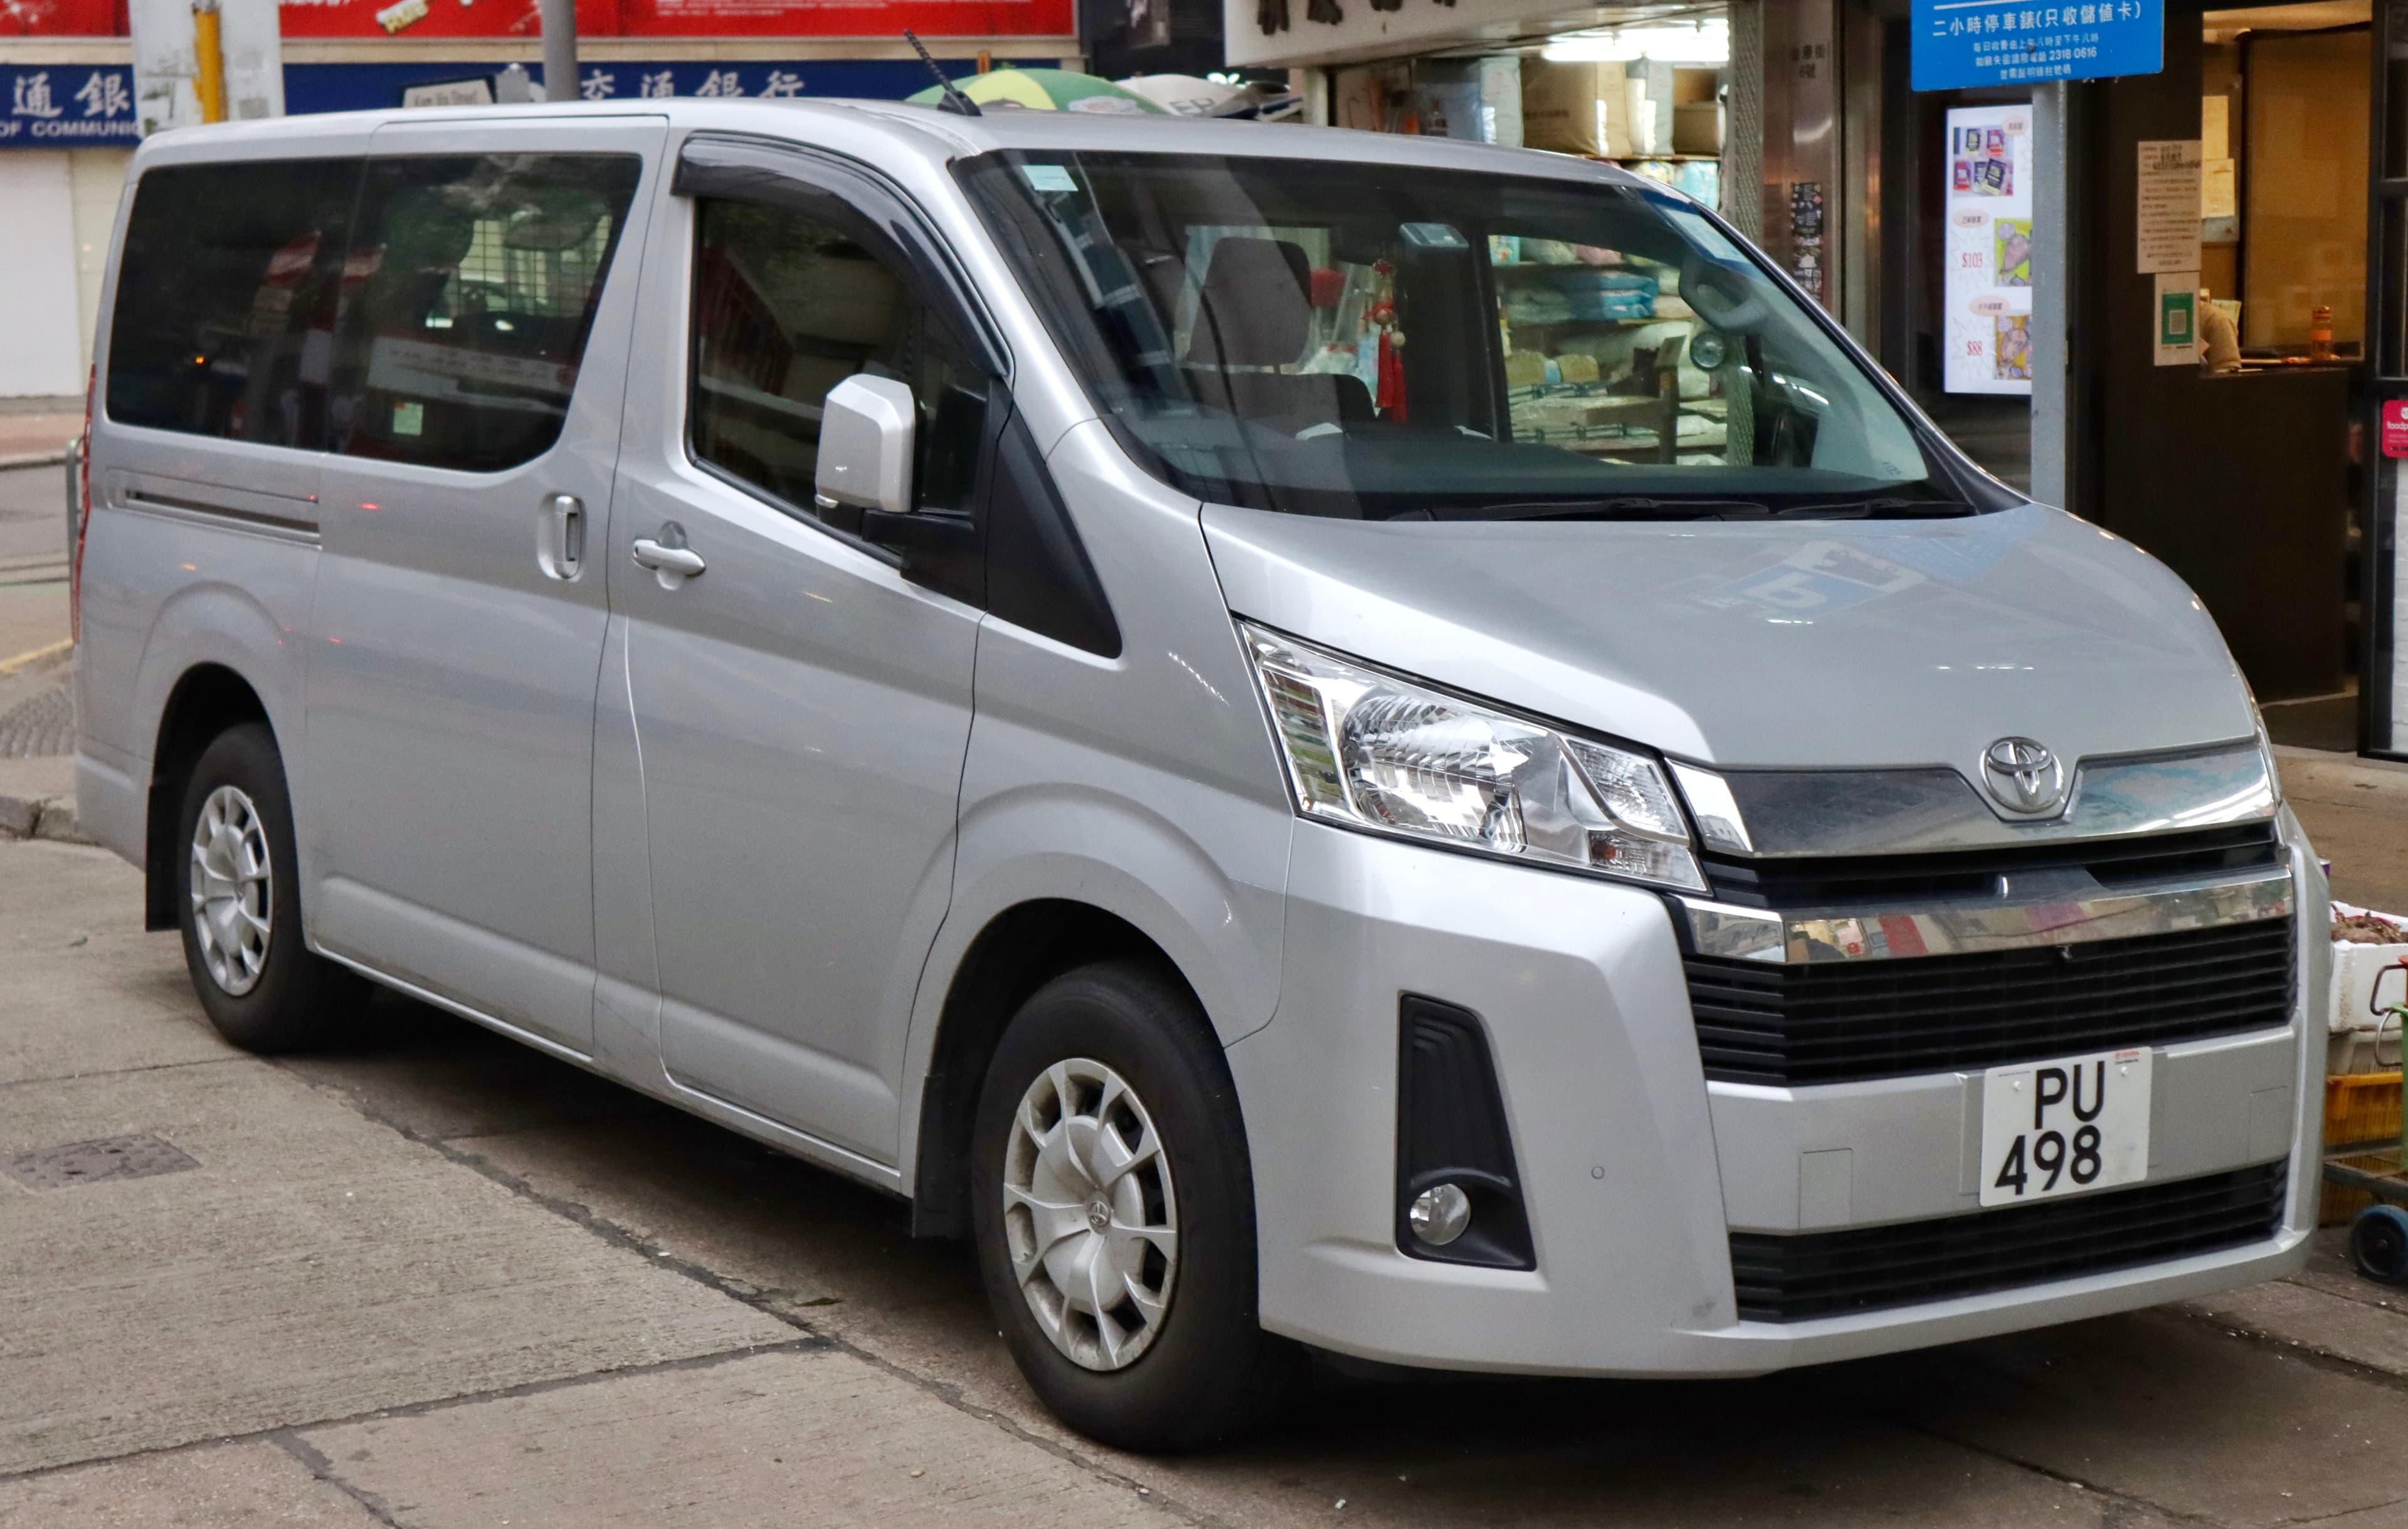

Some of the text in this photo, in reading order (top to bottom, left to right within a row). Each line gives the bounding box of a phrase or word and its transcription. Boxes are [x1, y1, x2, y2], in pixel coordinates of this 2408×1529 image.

[2049, 50, 2071, 61] 2318
[2074, 46, 2097, 59] 0616
[1962, 252, 1983, 268] $103
[1967, 341, 1982, 356] $88
[2034, 1061, 2104, 1130] PU
[1994, 1124, 2101, 1195] 498
